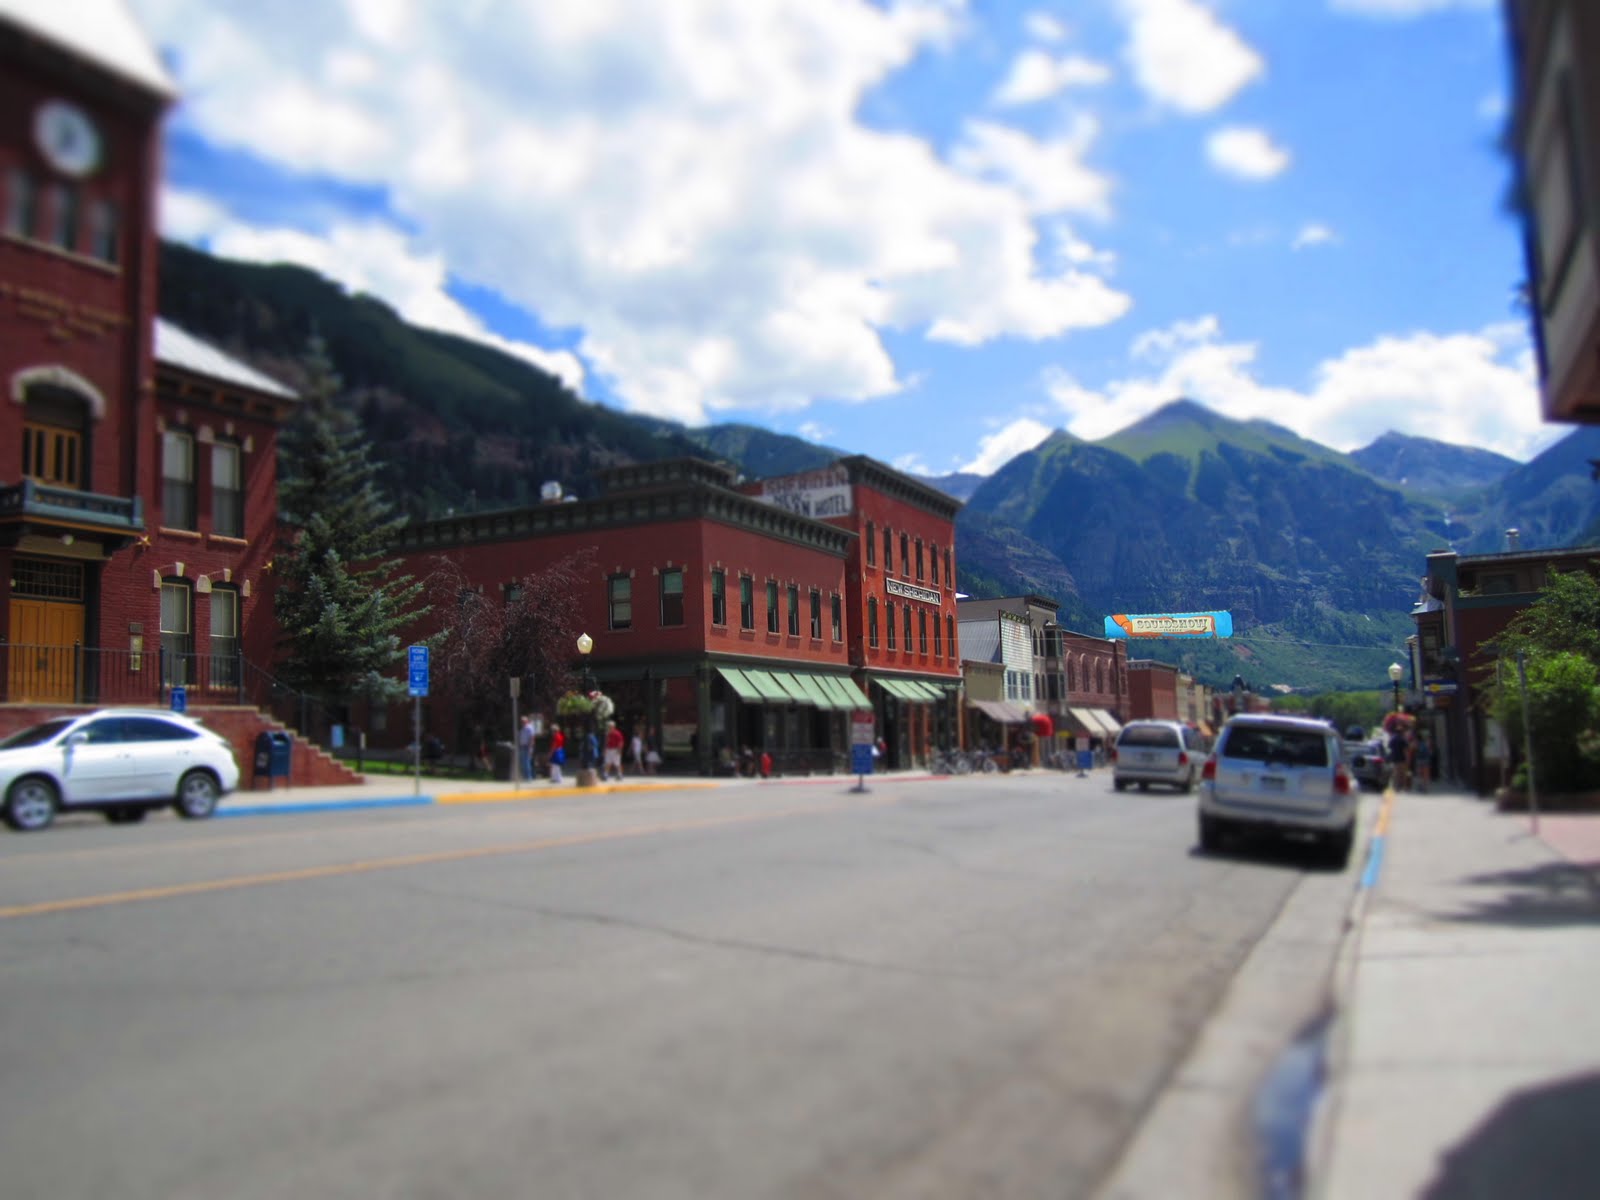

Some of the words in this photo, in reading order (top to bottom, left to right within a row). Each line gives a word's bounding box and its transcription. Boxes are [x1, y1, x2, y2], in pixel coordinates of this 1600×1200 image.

[815, 496, 848, 516] HOTEL
[887, 581, 903, 594] NEW
[904, 585, 939, 603] SHERIDAN
[1136, 618, 1208, 629] SQUIDSHOW
